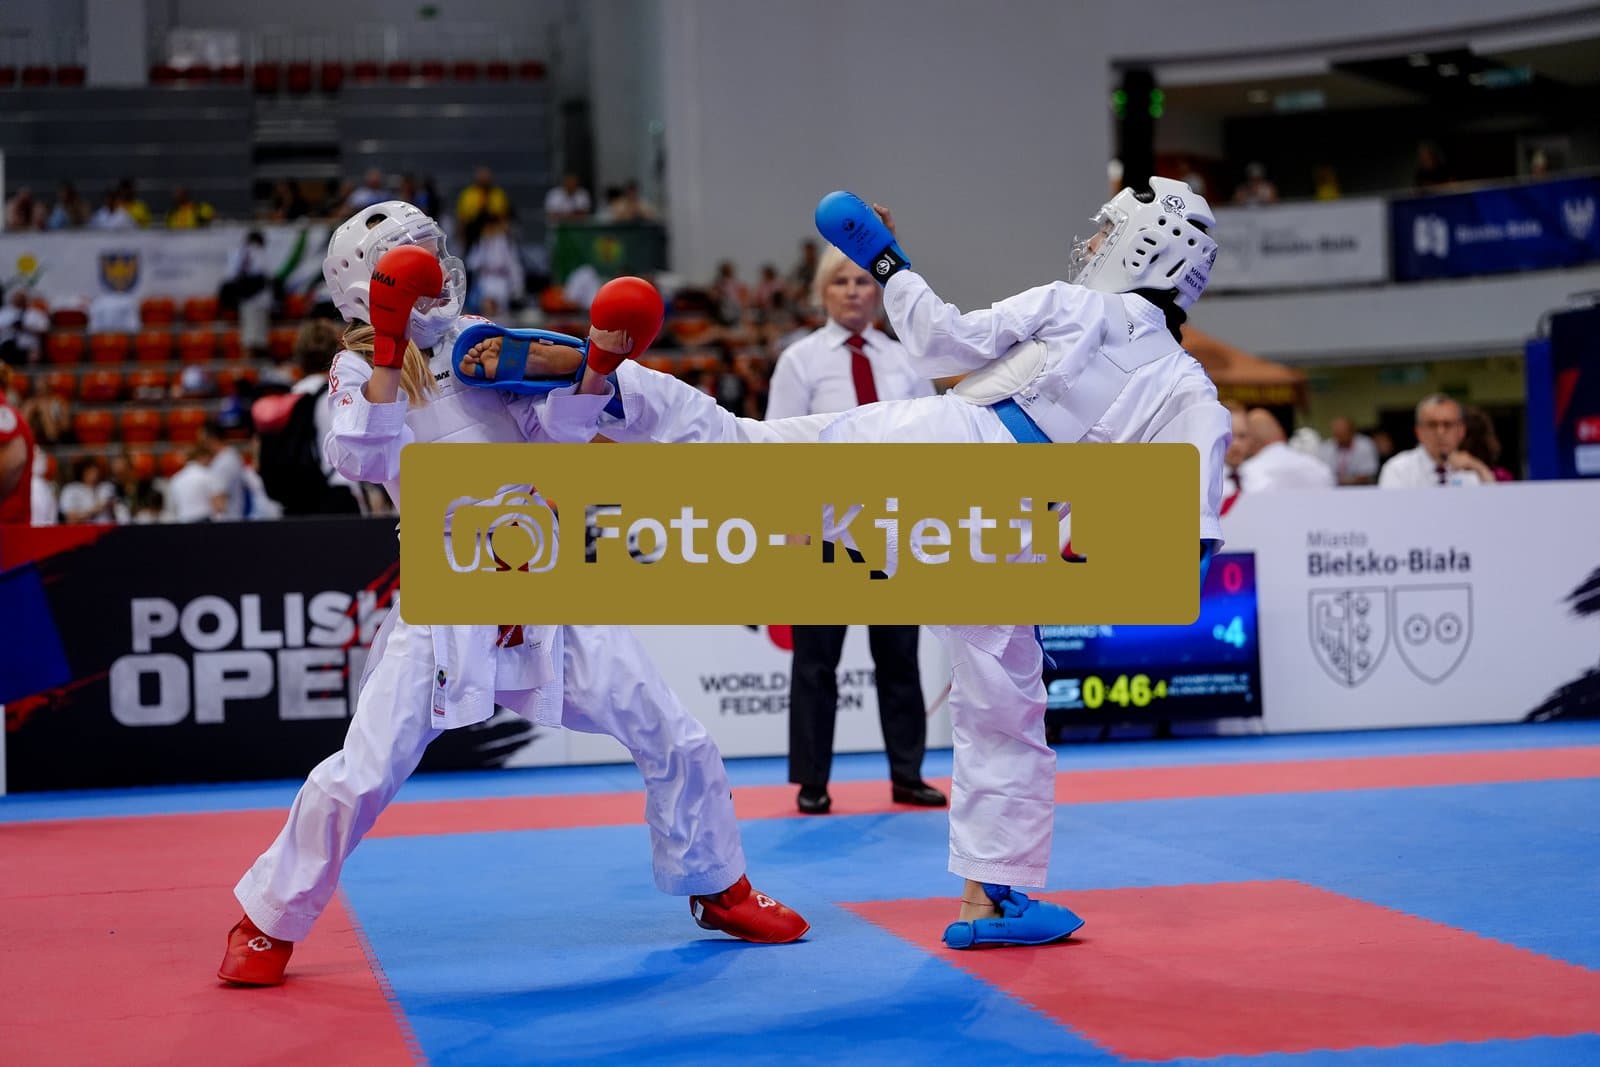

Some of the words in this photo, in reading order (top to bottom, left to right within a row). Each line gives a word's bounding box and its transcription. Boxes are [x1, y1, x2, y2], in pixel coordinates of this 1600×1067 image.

[1307, 547, 1472, 577] Bielsko-Biała
[1223, 563, 1242, 593] 0
[700, 672, 787, 694] WORLD
